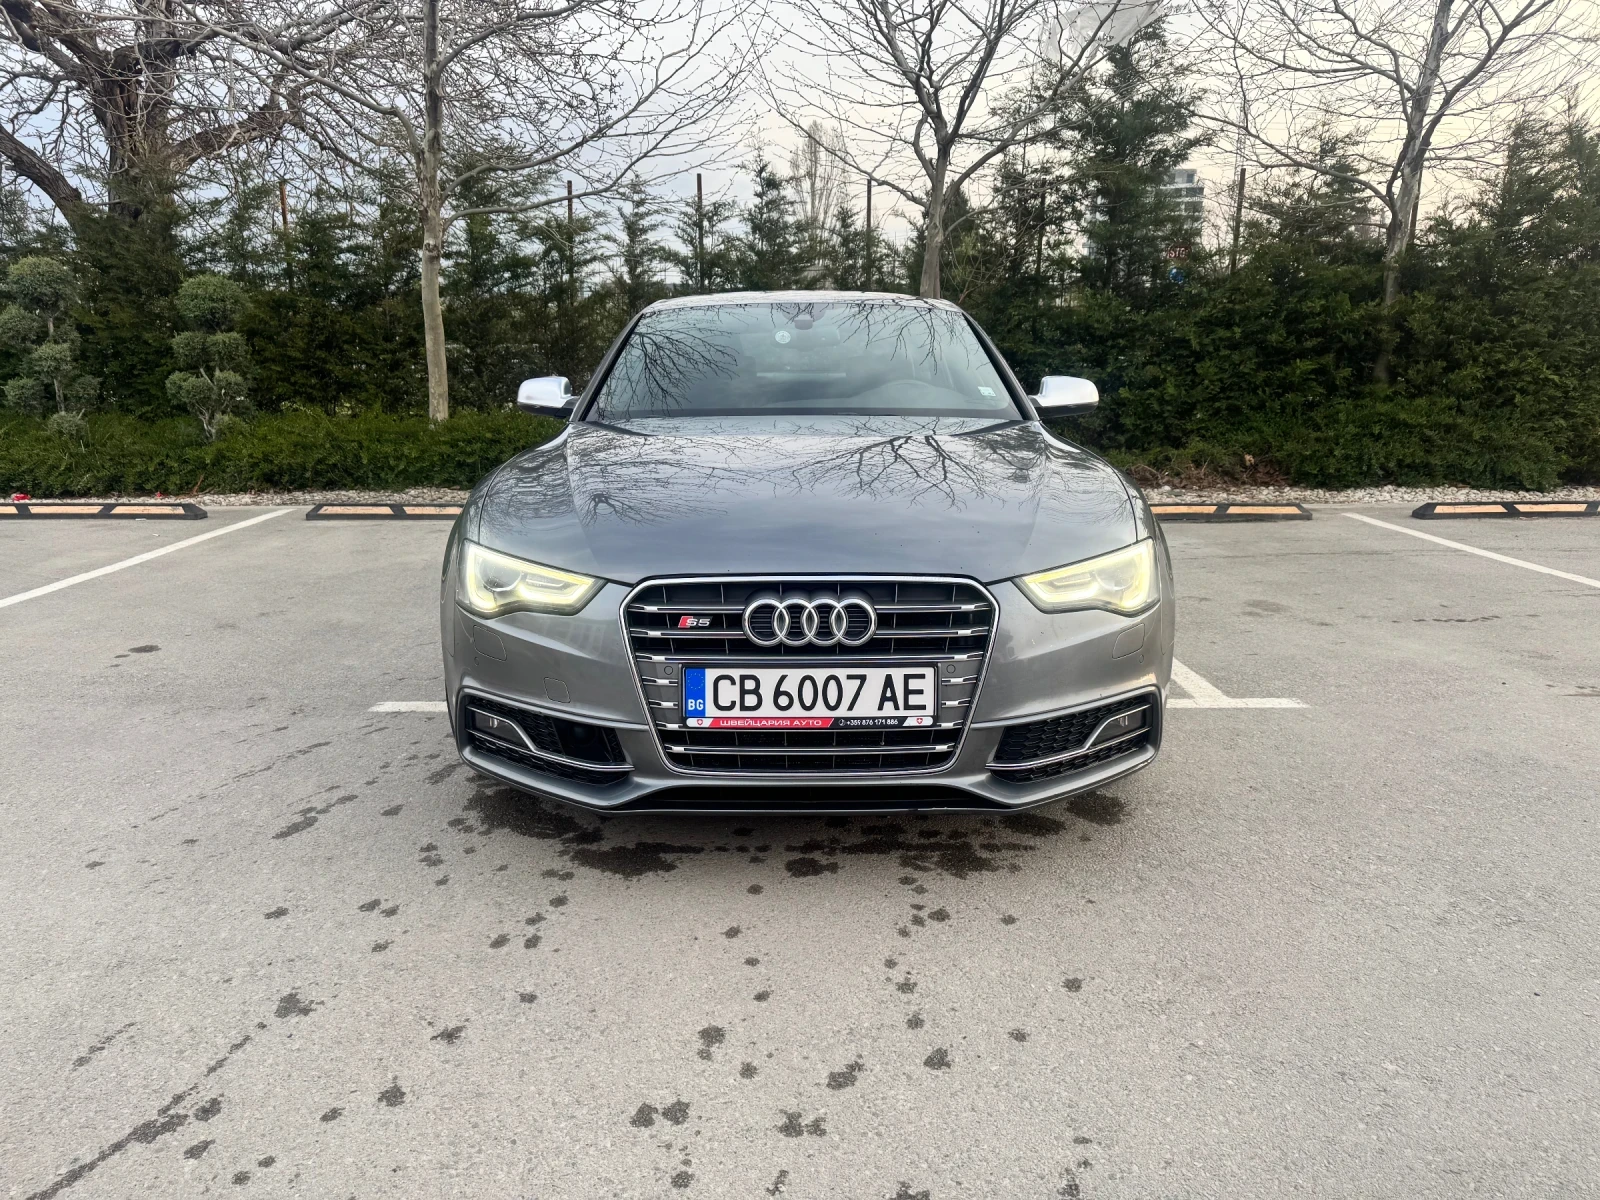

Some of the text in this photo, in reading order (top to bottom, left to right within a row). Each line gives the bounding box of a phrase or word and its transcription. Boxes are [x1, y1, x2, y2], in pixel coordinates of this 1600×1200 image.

[685, 618, 711, 627] S5
[713, 673, 926, 711] CB 6007 AE
[688, 699, 704, 711] BG
[720, 718, 822, 727] ШВЕЙЦАРИЯ АУТО
